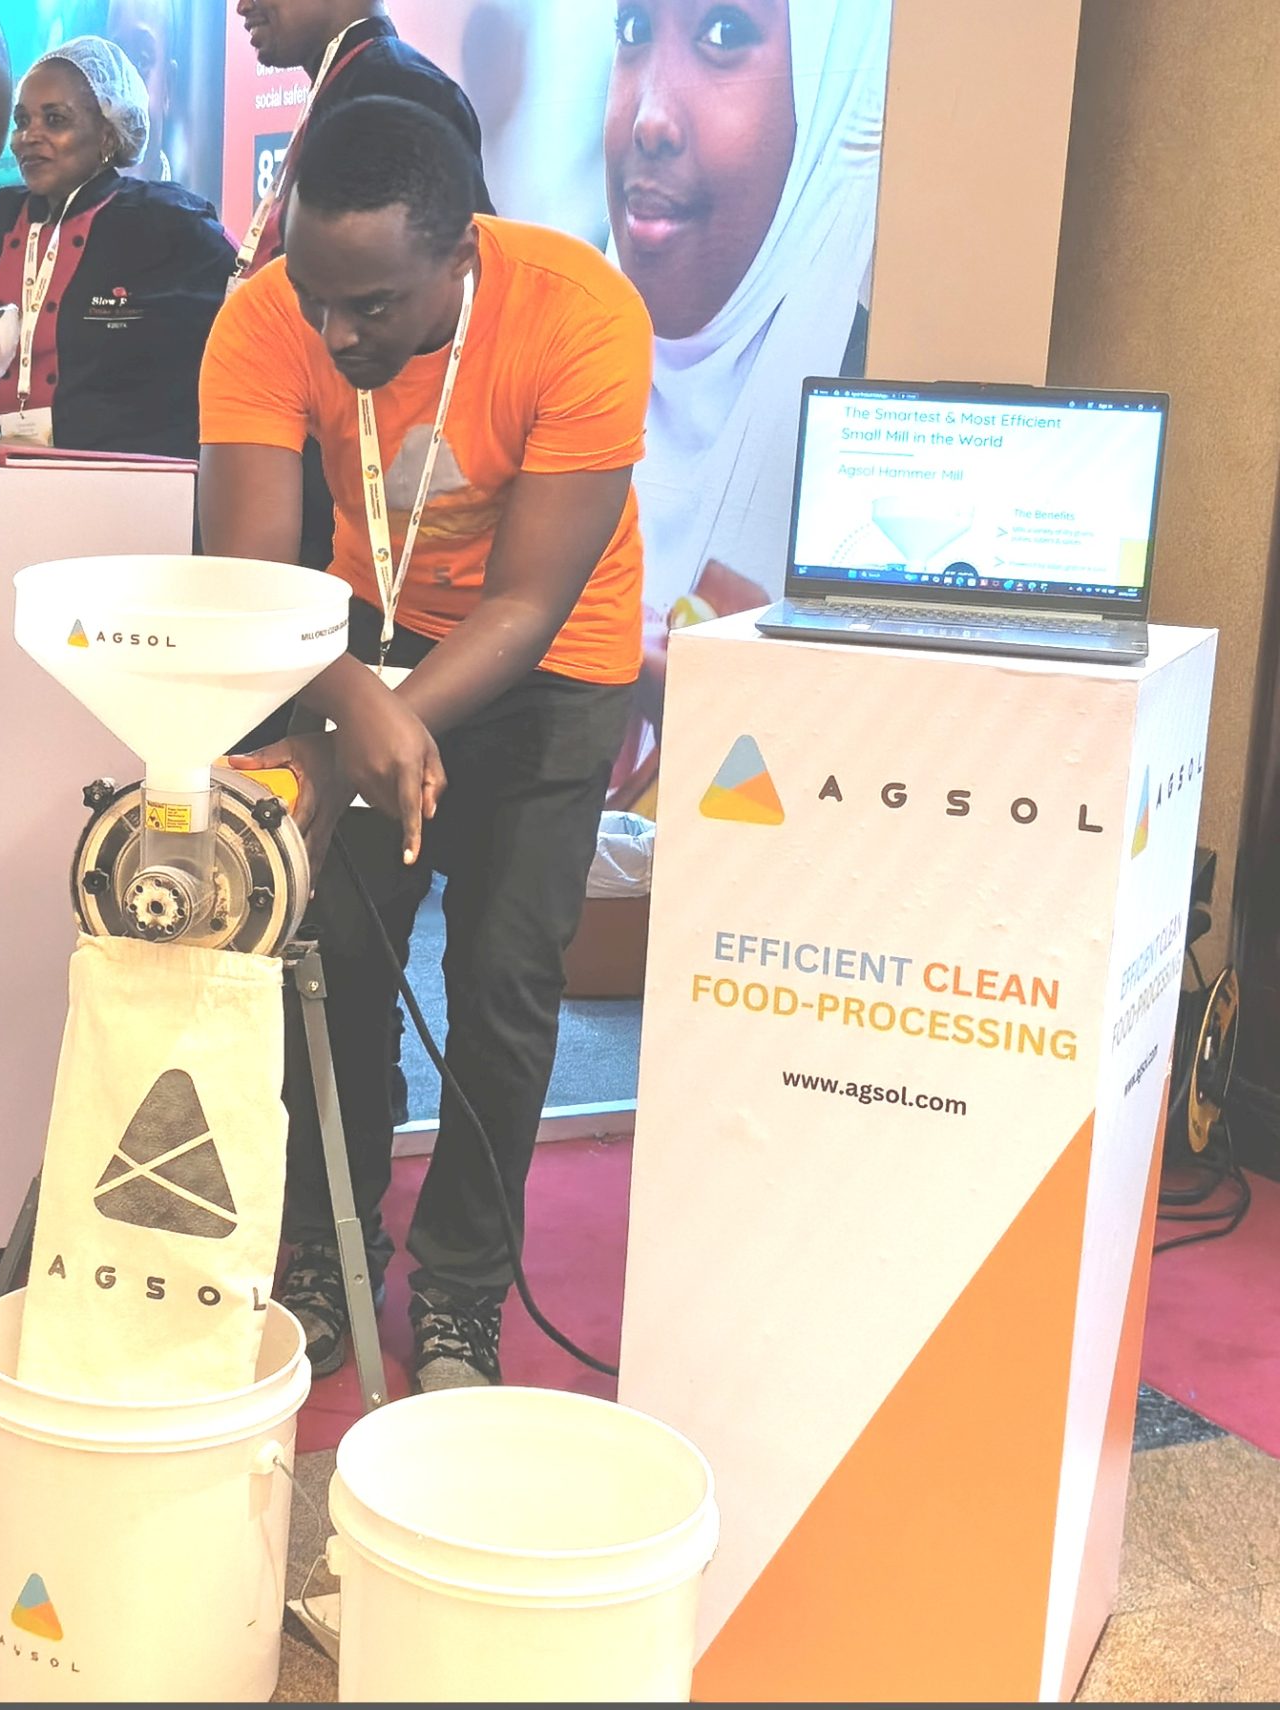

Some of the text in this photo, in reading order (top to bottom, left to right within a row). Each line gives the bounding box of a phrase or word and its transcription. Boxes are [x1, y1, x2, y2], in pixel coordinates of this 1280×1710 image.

[255, 84, 282, 109] social
[844, 406, 1062, 429] The Smartest & Most Efficient
[841, 427, 1004, 448] Small Mill in the World
[837, 463, 964, 481] Agsol Hammer Mill
[1014, 508, 1075, 521] The Benefits
[96, 631, 176, 648] AGSOL
[1155, 751, 1203, 811] AGSOL
[818, 775, 1104, 833] AGSOL
[714, 931, 1060, 1009] EFFICIENT CLEAN
[691, 974, 1079, 1062] FOOD-PROCESSING
[782, 1070, 968, 1116] www.agsol.com
[48, 1254, 267, 1311] AGSOL
